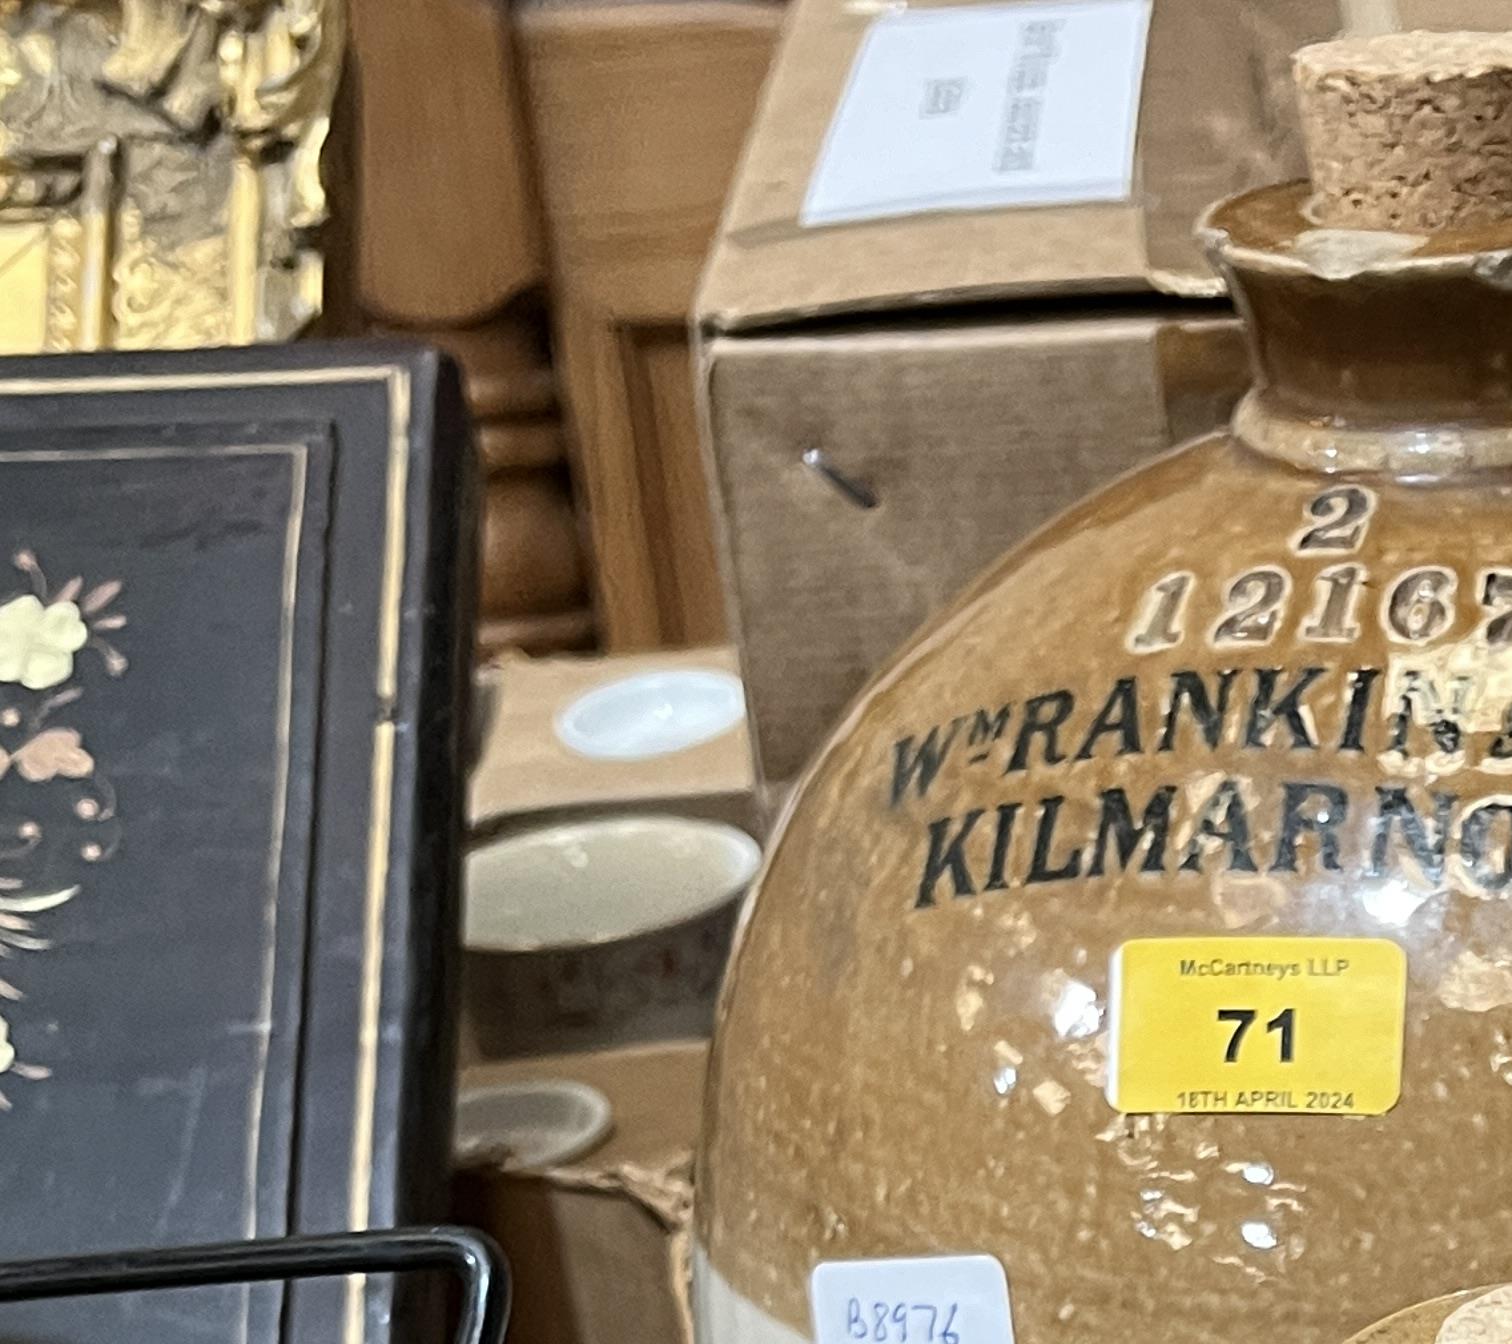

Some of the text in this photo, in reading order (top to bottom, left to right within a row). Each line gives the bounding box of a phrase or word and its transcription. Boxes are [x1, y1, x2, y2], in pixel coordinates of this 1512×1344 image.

[1295, 484, 1373, 556] 2
[1003, 666, 1470, 776] RANKIN
[1179, 957, 1350, 981] McCartneys LLP
[1217, 1008, 1296, 1064] 71
[1176, 1090, 1355, 1109] 18TH APRIL 2024
